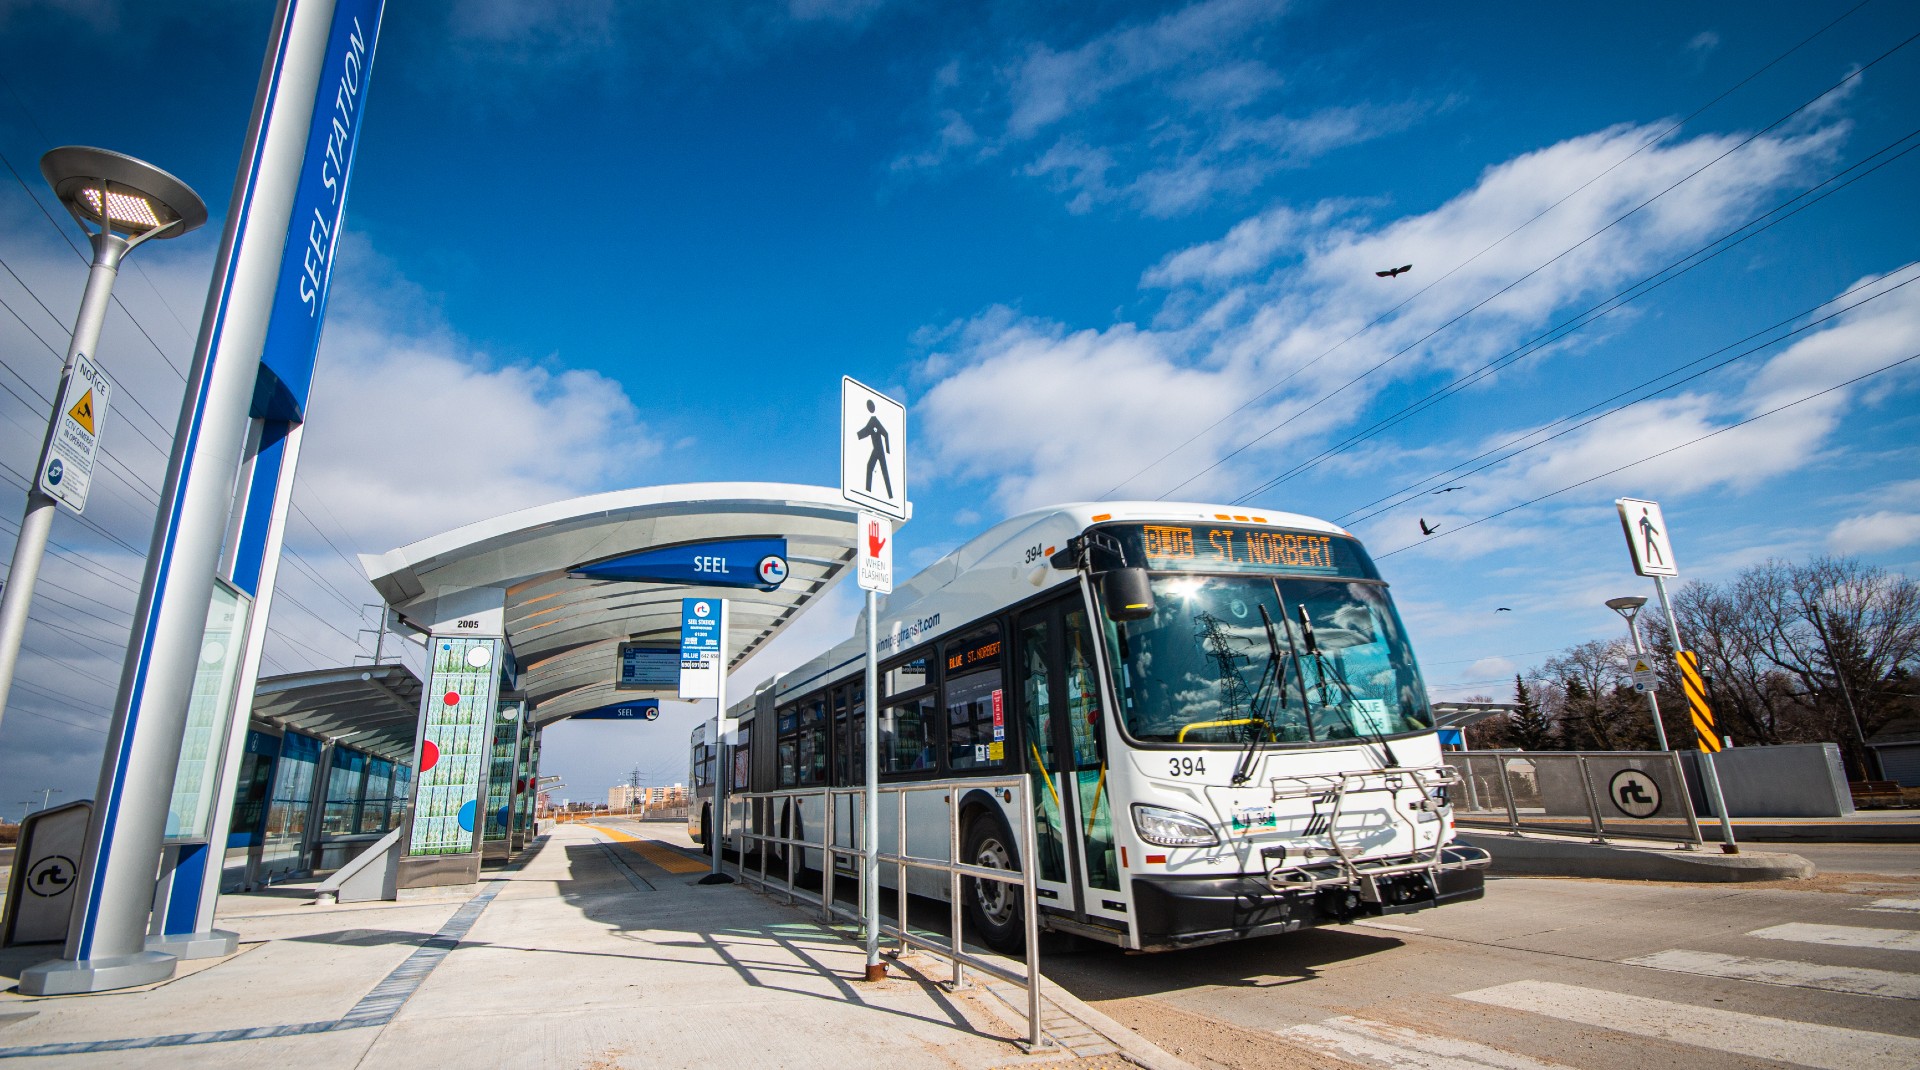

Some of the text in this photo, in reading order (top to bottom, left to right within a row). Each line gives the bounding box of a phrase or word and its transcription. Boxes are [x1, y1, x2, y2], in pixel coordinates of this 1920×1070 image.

[300, 16, 365, 318] SEEL STATION
[80, 363, 106, 396] NOTICE
[65, 418, 94, 447] CCTV CAMERAS
[69, 434, 90, 455] OPERATION
[1025, 542, 1042, 564] 394
[1208, 529, 1243, 562] ST.
[1246, 531, 1332, 568] NORBERT
[693, 555, 730, 574] SEEL
[865, 558, 886, 571] WHEN
[861, 567, 889, 584] FLASHING
[457, 620, 479, 629] 2005
[949, 641, 1001, 669] BLUE ST. NORBERT
[617, 708, 633, 717] SEEL
[1169, 756, 1206, 777] 394
